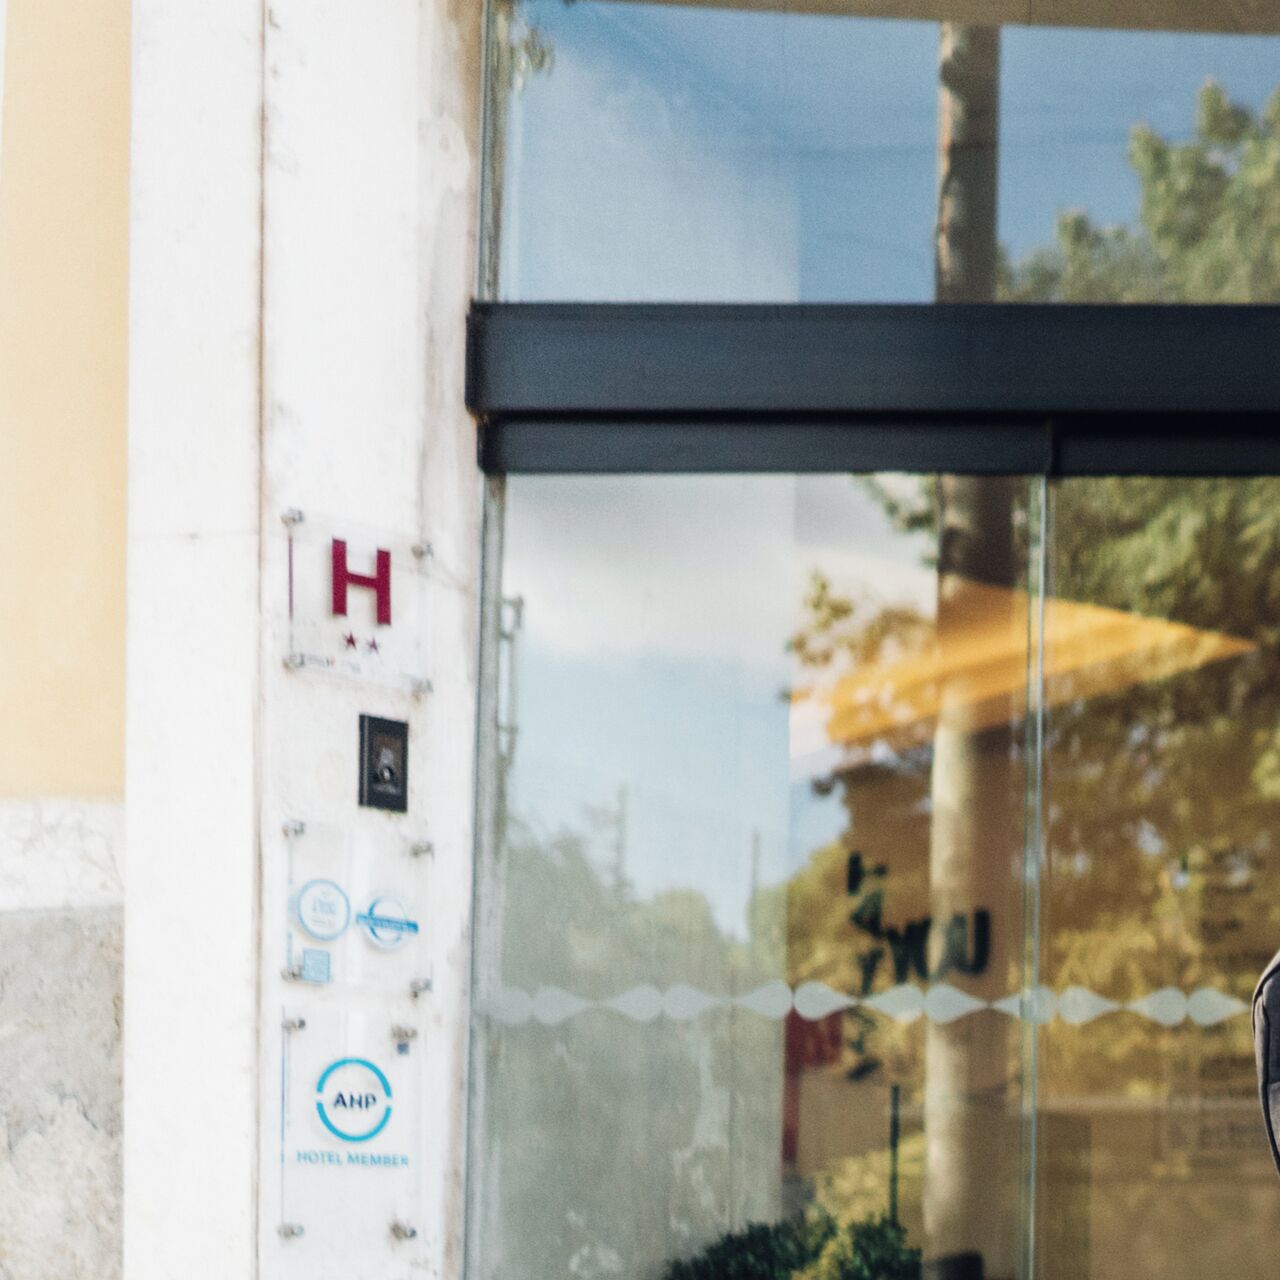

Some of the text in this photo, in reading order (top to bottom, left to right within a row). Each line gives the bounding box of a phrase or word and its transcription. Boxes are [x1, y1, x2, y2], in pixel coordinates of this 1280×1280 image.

[332, 537, 391, 626] H
[333, 1091, 377, 1110] AHP
[296, 1150, 409, 1168] HOTEL MEMBER
